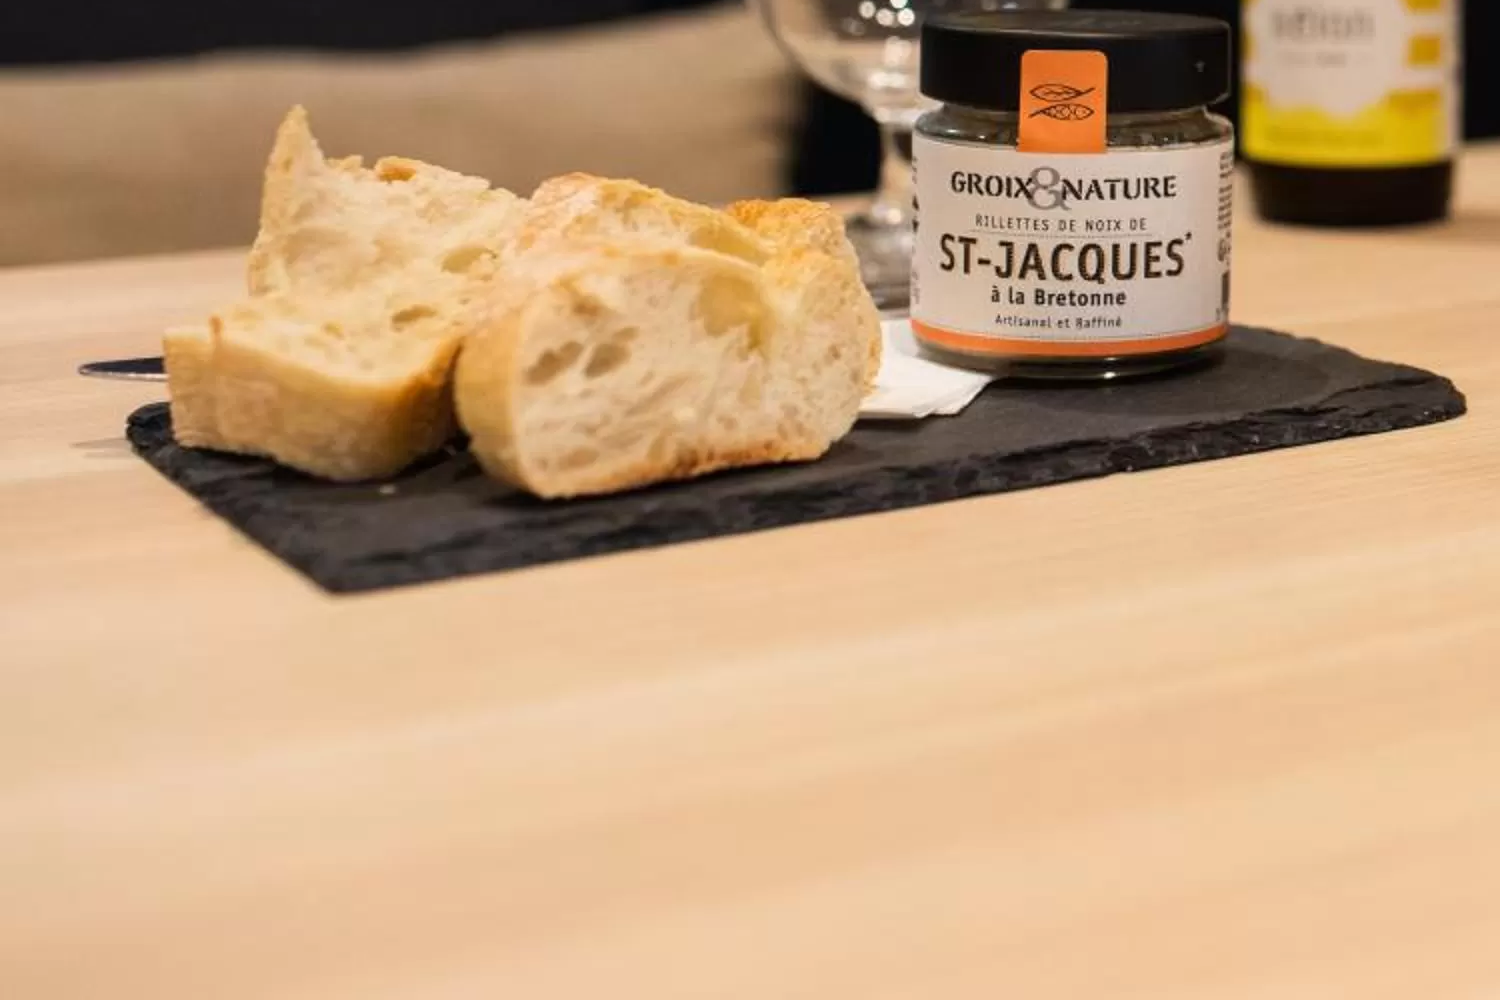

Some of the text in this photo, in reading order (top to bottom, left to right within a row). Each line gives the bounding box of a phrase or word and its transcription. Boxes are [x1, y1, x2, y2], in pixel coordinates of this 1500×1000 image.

[976, 214, 1147, 232] RILLETTES DE NOIX DE
[991, 285, 1127, 307] à la Bretonne
[1057, 318, 1070, 329] et
[1075, 317, 1122, 330] Raffiné
